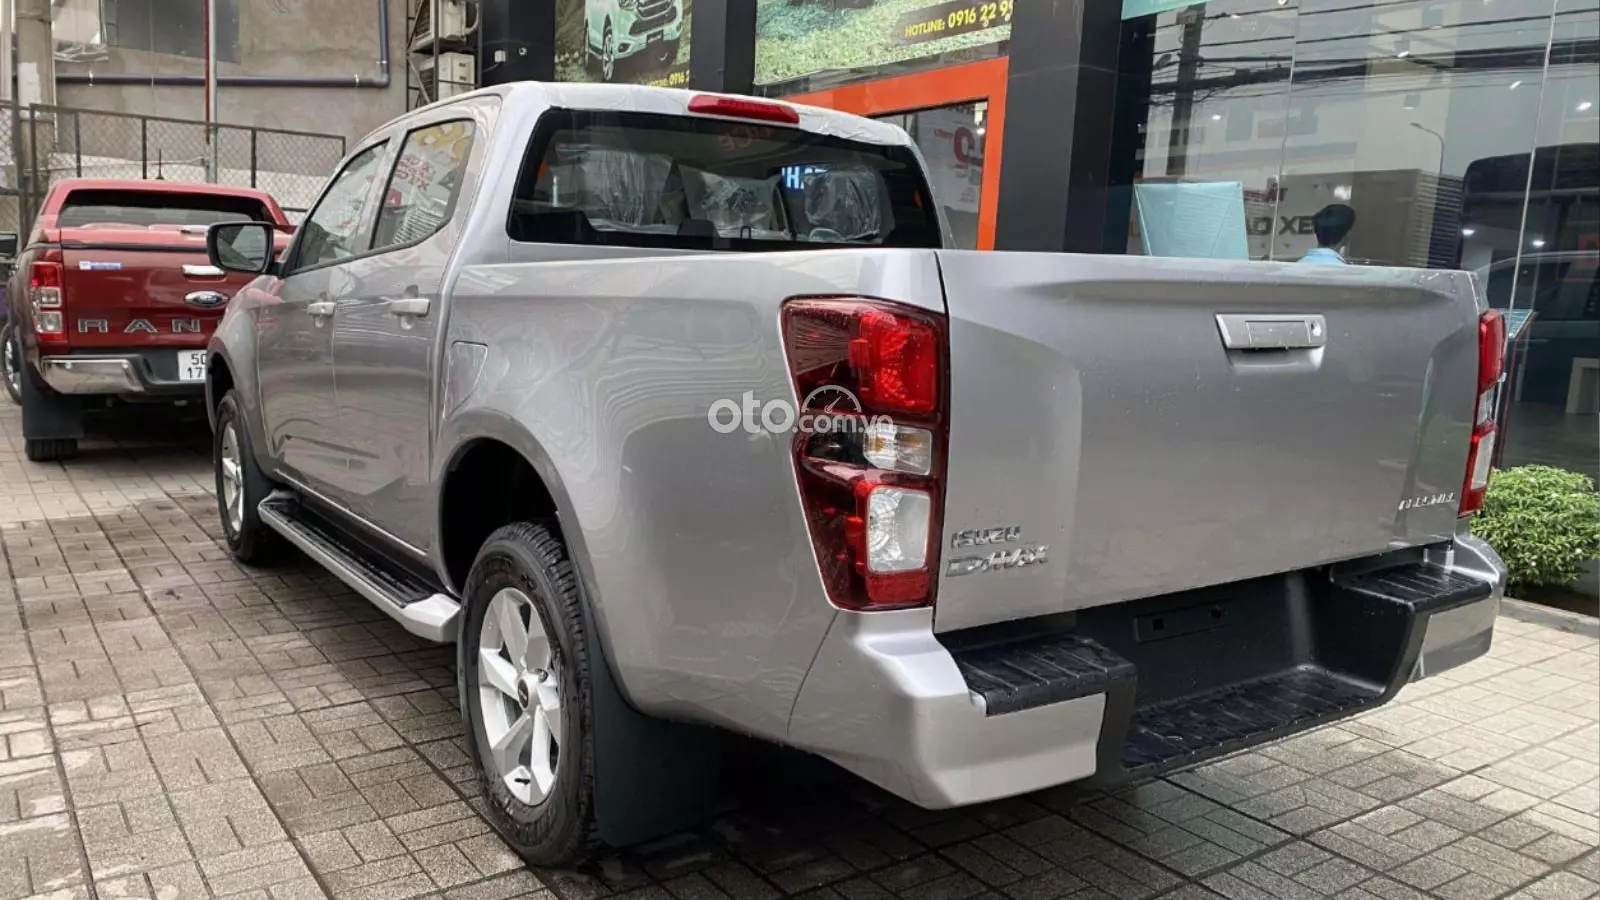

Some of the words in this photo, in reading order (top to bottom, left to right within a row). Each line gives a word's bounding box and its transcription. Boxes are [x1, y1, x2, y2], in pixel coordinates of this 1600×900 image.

[904, 18, 945, 38] HOTLINE:
[947, 7, 977, 28] 0916
[980, 2, 997, 21] 22
[1278, 215, 1315, 236] XE
[78, 319, 222, 333] RAN
[951, 526, 1021, 549] ISUZU
